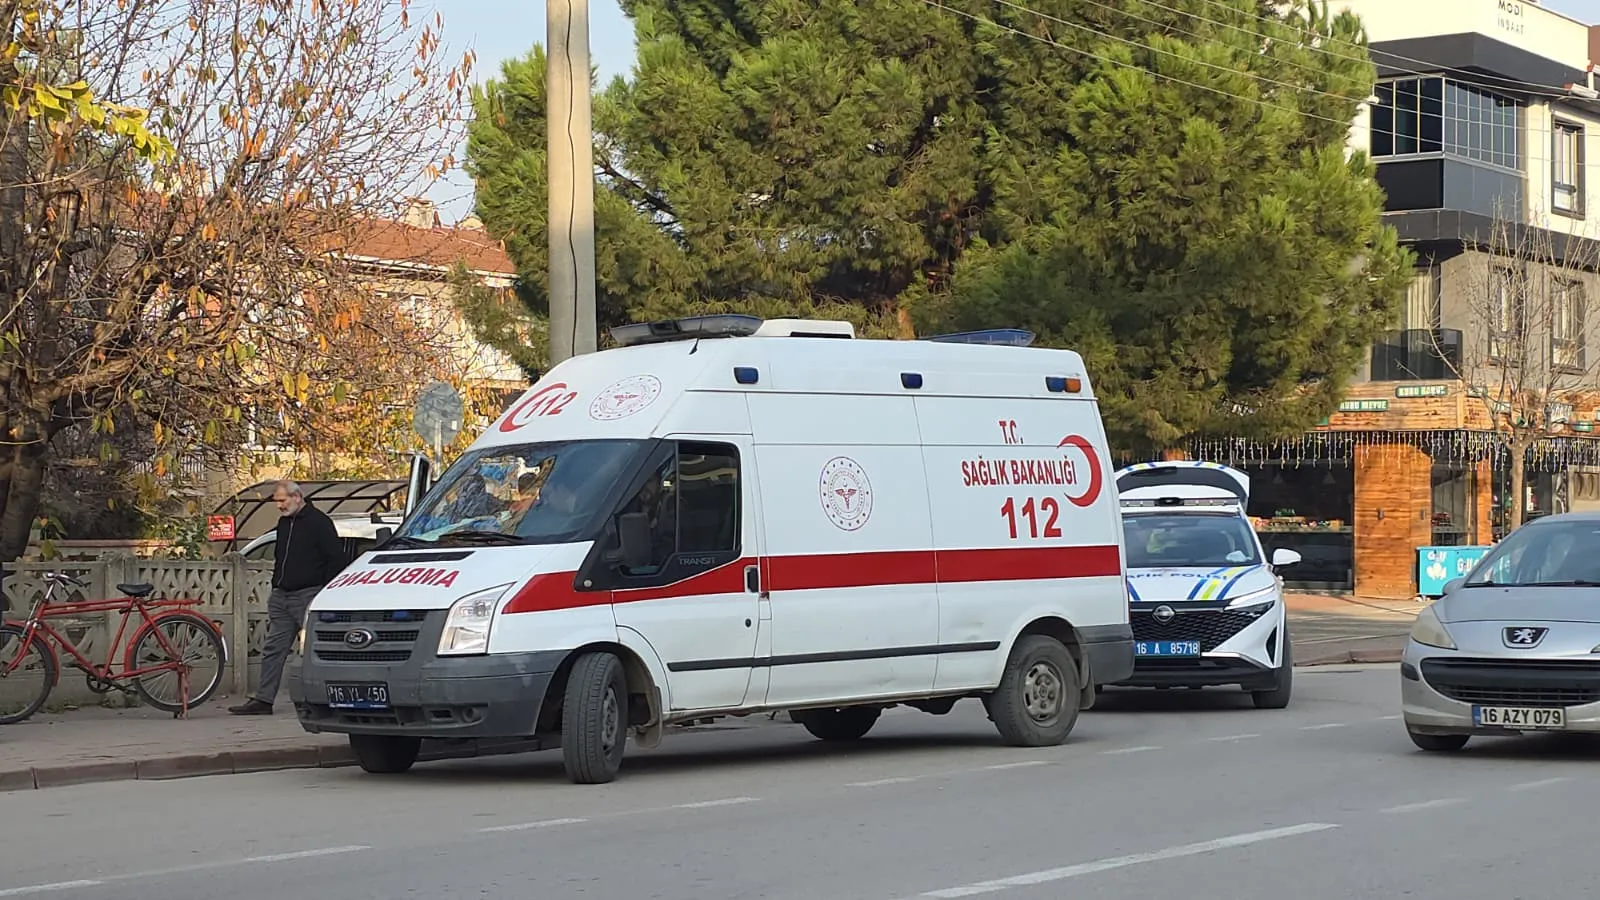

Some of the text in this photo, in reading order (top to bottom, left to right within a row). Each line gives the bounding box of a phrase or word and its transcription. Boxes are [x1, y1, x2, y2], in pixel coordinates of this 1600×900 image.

[524, 391, 578, 419] 112
[999, 420, 1024, 444] T.C.
[962, 454, 1077, 486] SAĞLIK BAKANLIĞI
[1001, 497, 1062, 539] 112
[1136, 642, 1199, 654] 16 A 85718
[333, 687, 345, 702] 16
[1482, 708, 1561, 725] 16 AZY 079
